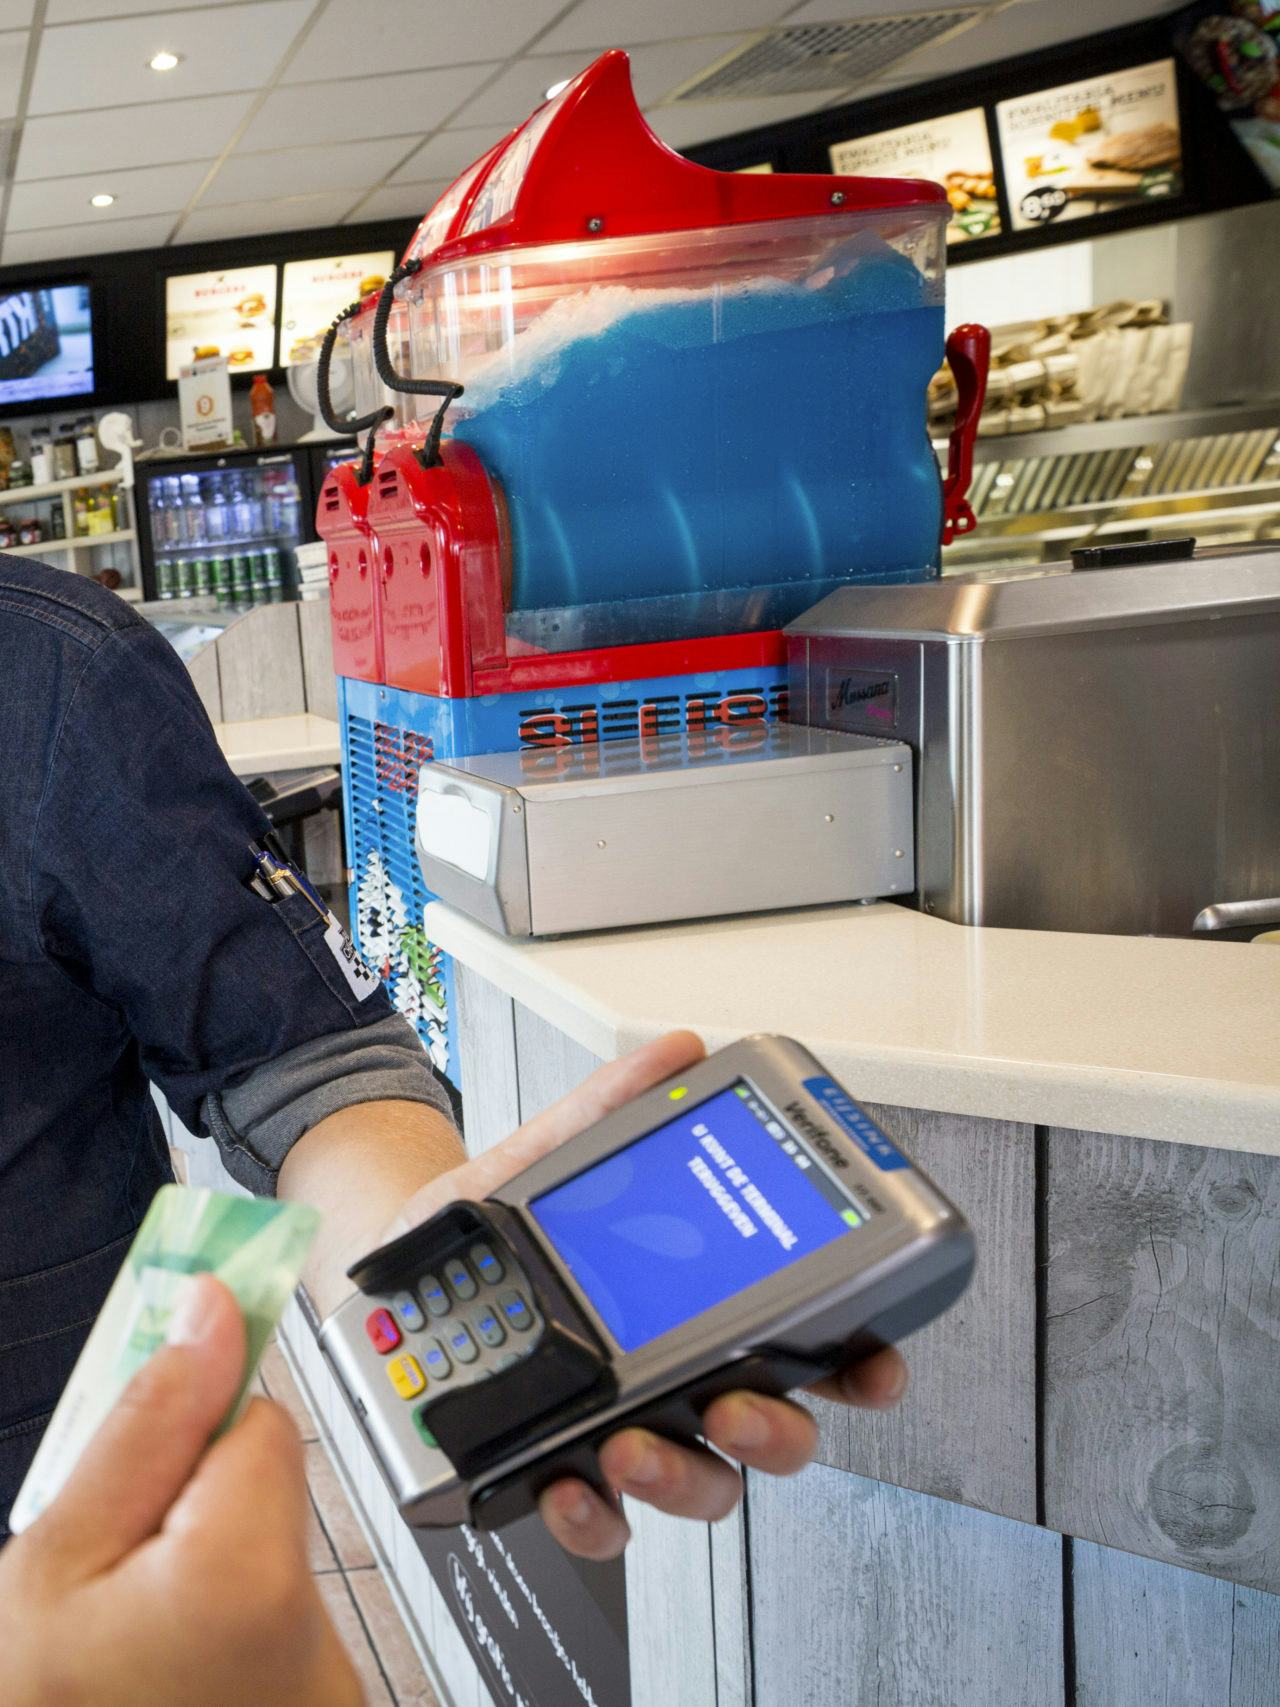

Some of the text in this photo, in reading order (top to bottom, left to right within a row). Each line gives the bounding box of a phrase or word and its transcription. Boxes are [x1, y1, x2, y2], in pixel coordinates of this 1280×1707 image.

[785, 1101, 850, 1169] Verifone
[687, 1155, 759, 1238] TERUGGEVEN
[699, 1133, 736, 1170] KUNT
[725, 1166, 750, 1188] DE
[740, 1182, 798, 1251] TERMINAL
